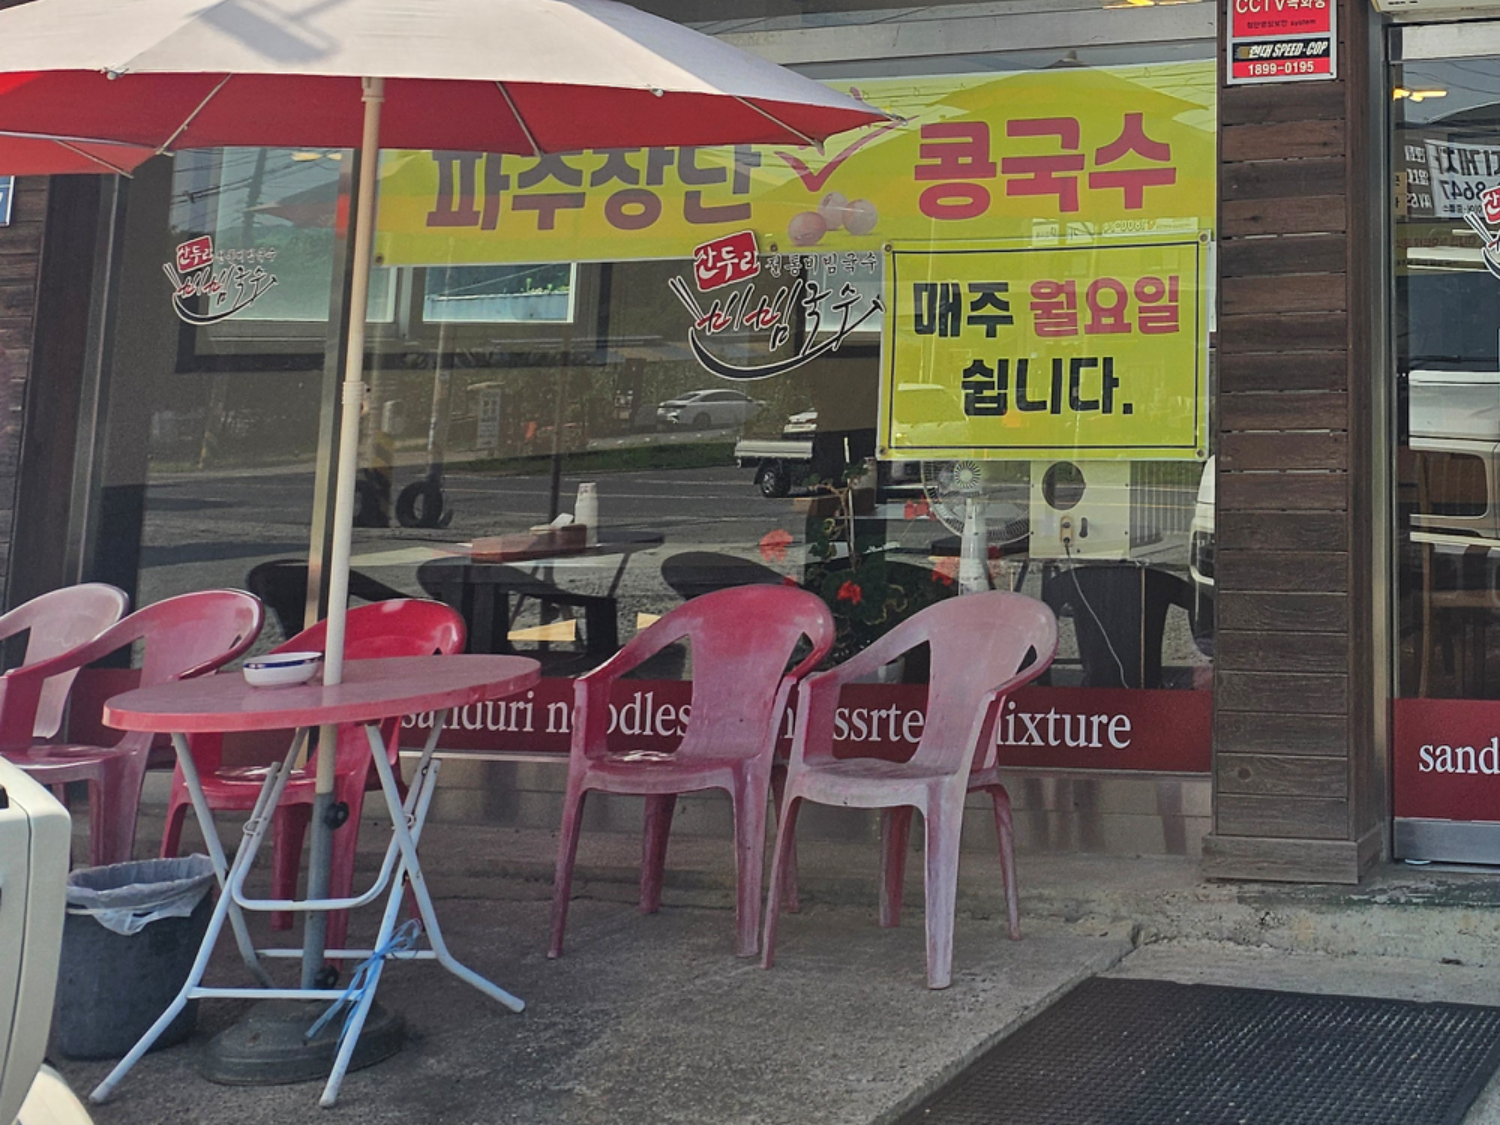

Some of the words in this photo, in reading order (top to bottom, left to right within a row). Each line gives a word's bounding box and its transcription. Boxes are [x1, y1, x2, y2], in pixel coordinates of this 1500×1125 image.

[1247, 60, 1314, 76] 1899-0195
[426, 146, 762, 230] 파주장단
[914, 112, 1177, 220] 콩국수
[179, 244, 213, 265] 산두리
[694, 245, 760, 280] 산두리
[912, 281, 1015, 338] 매주
[1030, 275, 1181, 338] 월요일
[962, 356, 1134, 417] 쉽니다.
[546, 690, 693, 738] ndles
[997, 701, 1132, 749] ixture
